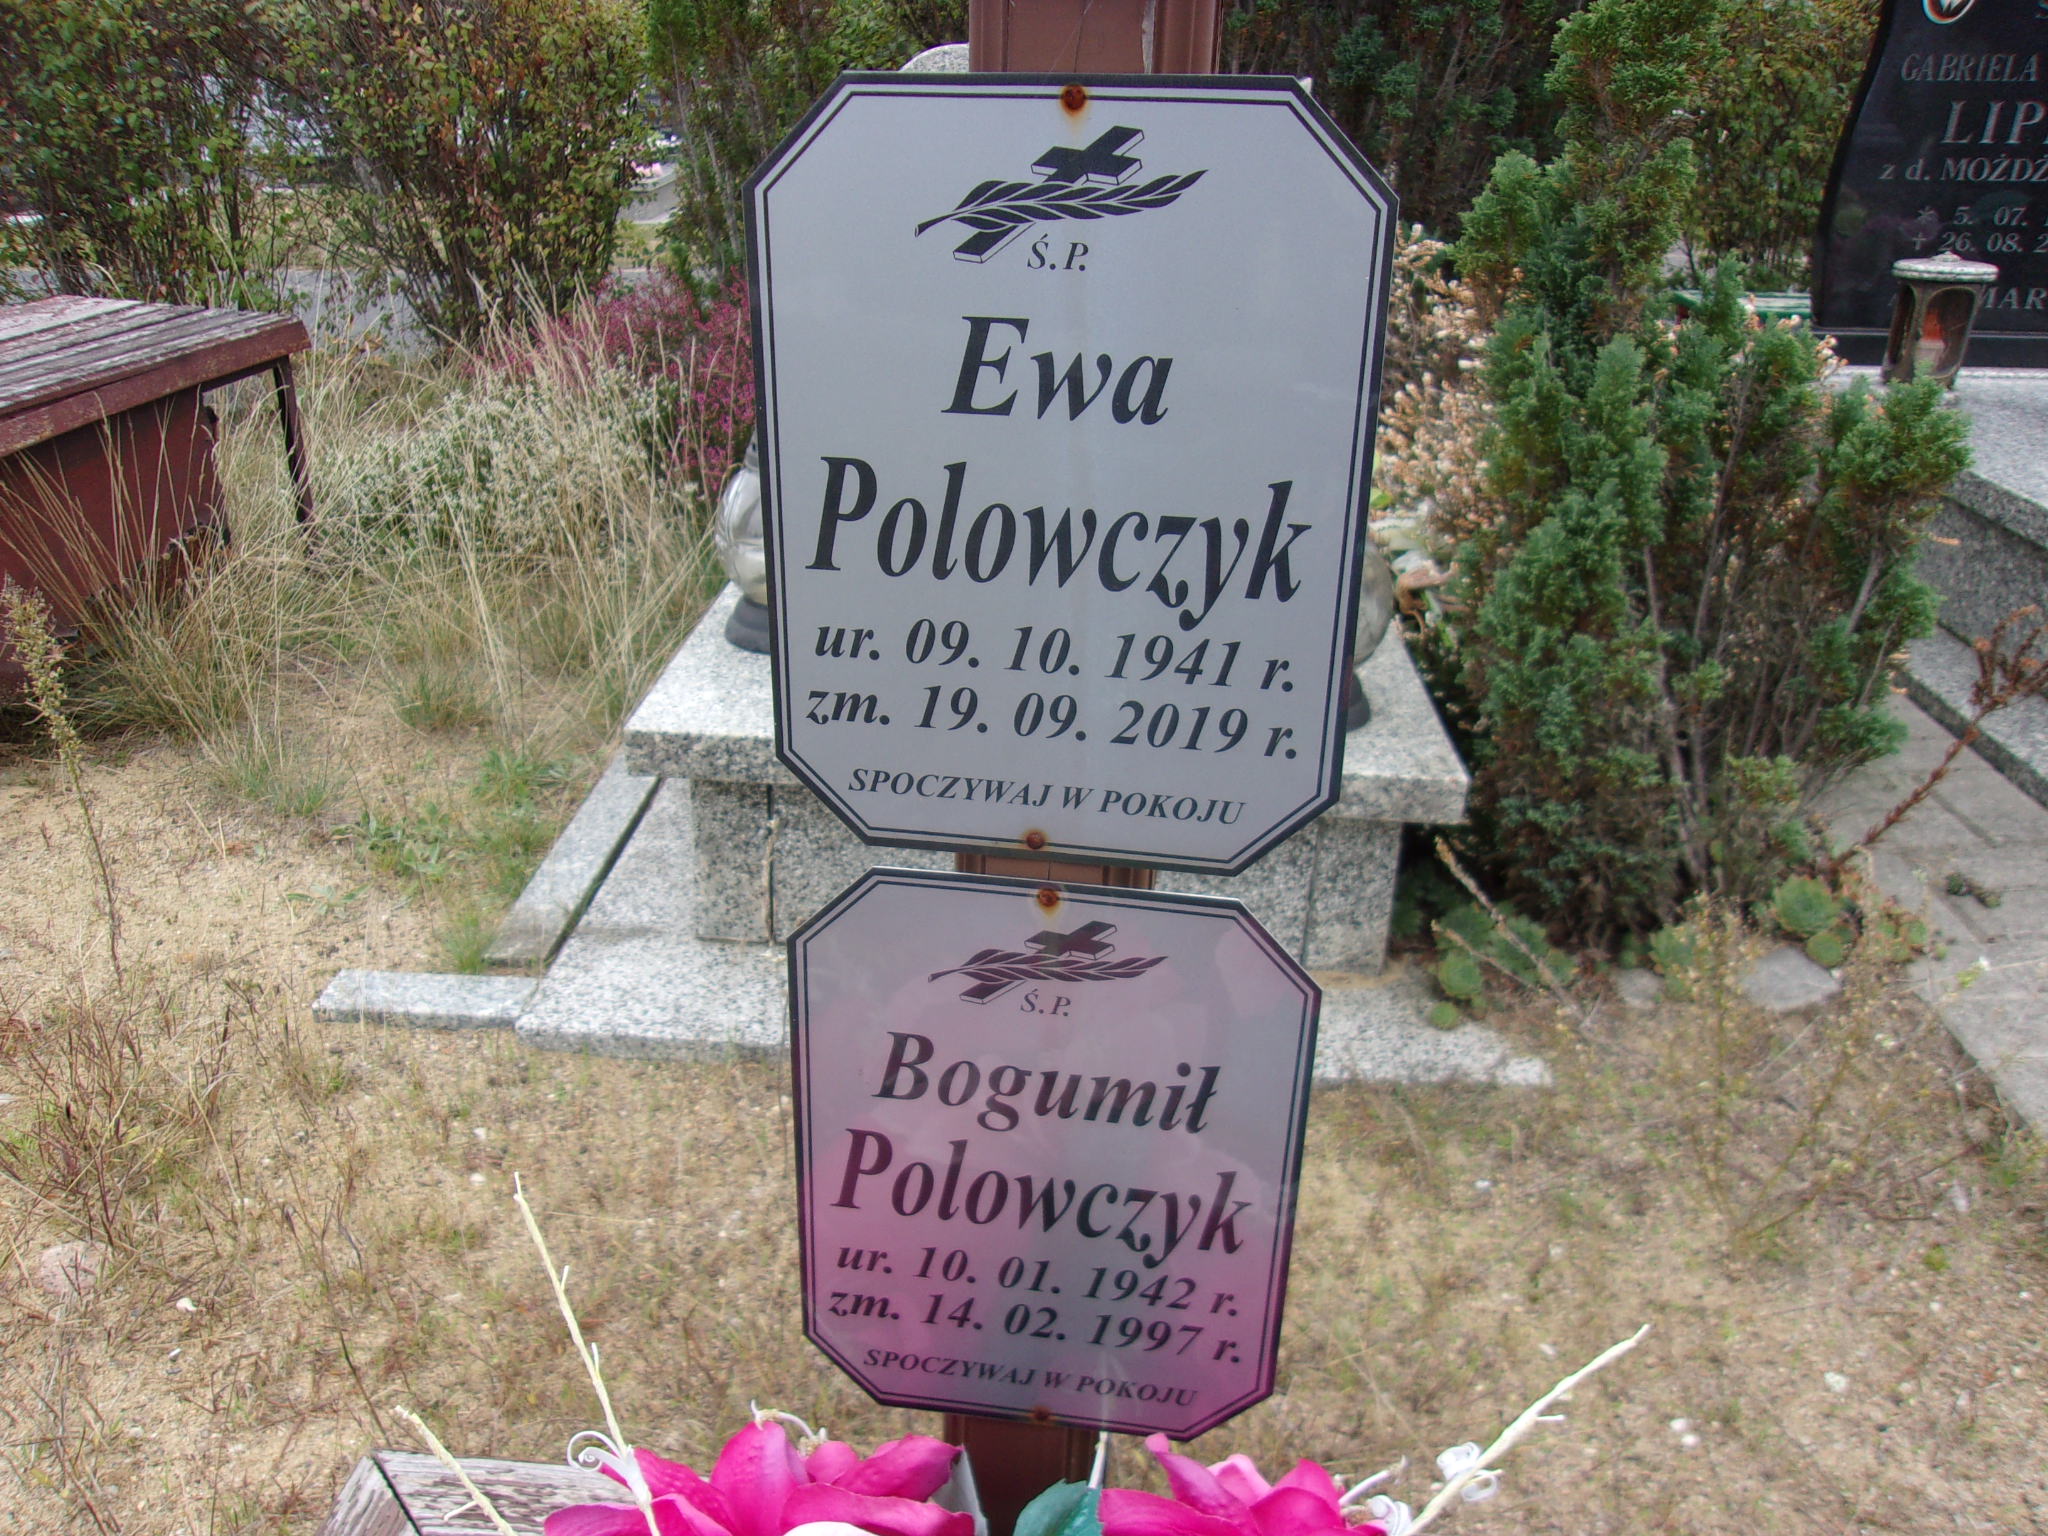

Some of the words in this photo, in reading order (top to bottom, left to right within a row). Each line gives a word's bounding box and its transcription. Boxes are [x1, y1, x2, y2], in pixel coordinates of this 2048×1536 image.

[1901, 53, 2040, 81] GABRIELA
[1942, 231, 1976, 252] 26.
[1987, 232, 2023, 252] 08.
[1953, 206, 1974, 225] 5.
[1993, 206, 2028, 226] 07.
[941, 316, 1173, 425] Ewa
[805, 456, 1312, 631] Polowczyk
[815, 625, 880, 660] ur.
[906, 618, 980, 668] 09.
[1004, 626, 1079, 676] 10.
[1104, 634, 1241, 687] 1941
[1259, 657, 1294, 692] r.
[805, 689, 890, 726] zm.
[914, 685, 988, 734] 19.
[1014, 692, 1087, 742] 09.
[1110, 700, 1249, 754] 2019
[1263, 725, 1297, 760] r.
[848, 768, 1049, 808] SPOCZYWAJ
[1063, 786, 1094, 810] W
[1098, 790, 1247, 826] POKOJU
[871, 1032, 1221, 1134] Bogumił
[830, 1128, 1252, 1270] Polowczyk
[837, 1245, 893, 1275] ur.
[913, 1246, 977, 1283] 10.
[998, 1257, 1061, 1294] 01.
[1082, 1267, 1197, 1310] 1942
[1209, 1291, 1238, 1317] r.
[828, 1291, 900, 1321] zm.
[920, 1293, 983, 1331] 14.
[1004, 1303, 1066, 1341] 02.
[1088, 1314, 1204, 1356] 1997
[1212, 1338, 1241, 1364] r.
[863, 1348, 1037, 1386] SPOCZYWAJ
[1043, 1370, 1070, 1389] W
[1075, 1375, 1198, 1407] POKOJU
